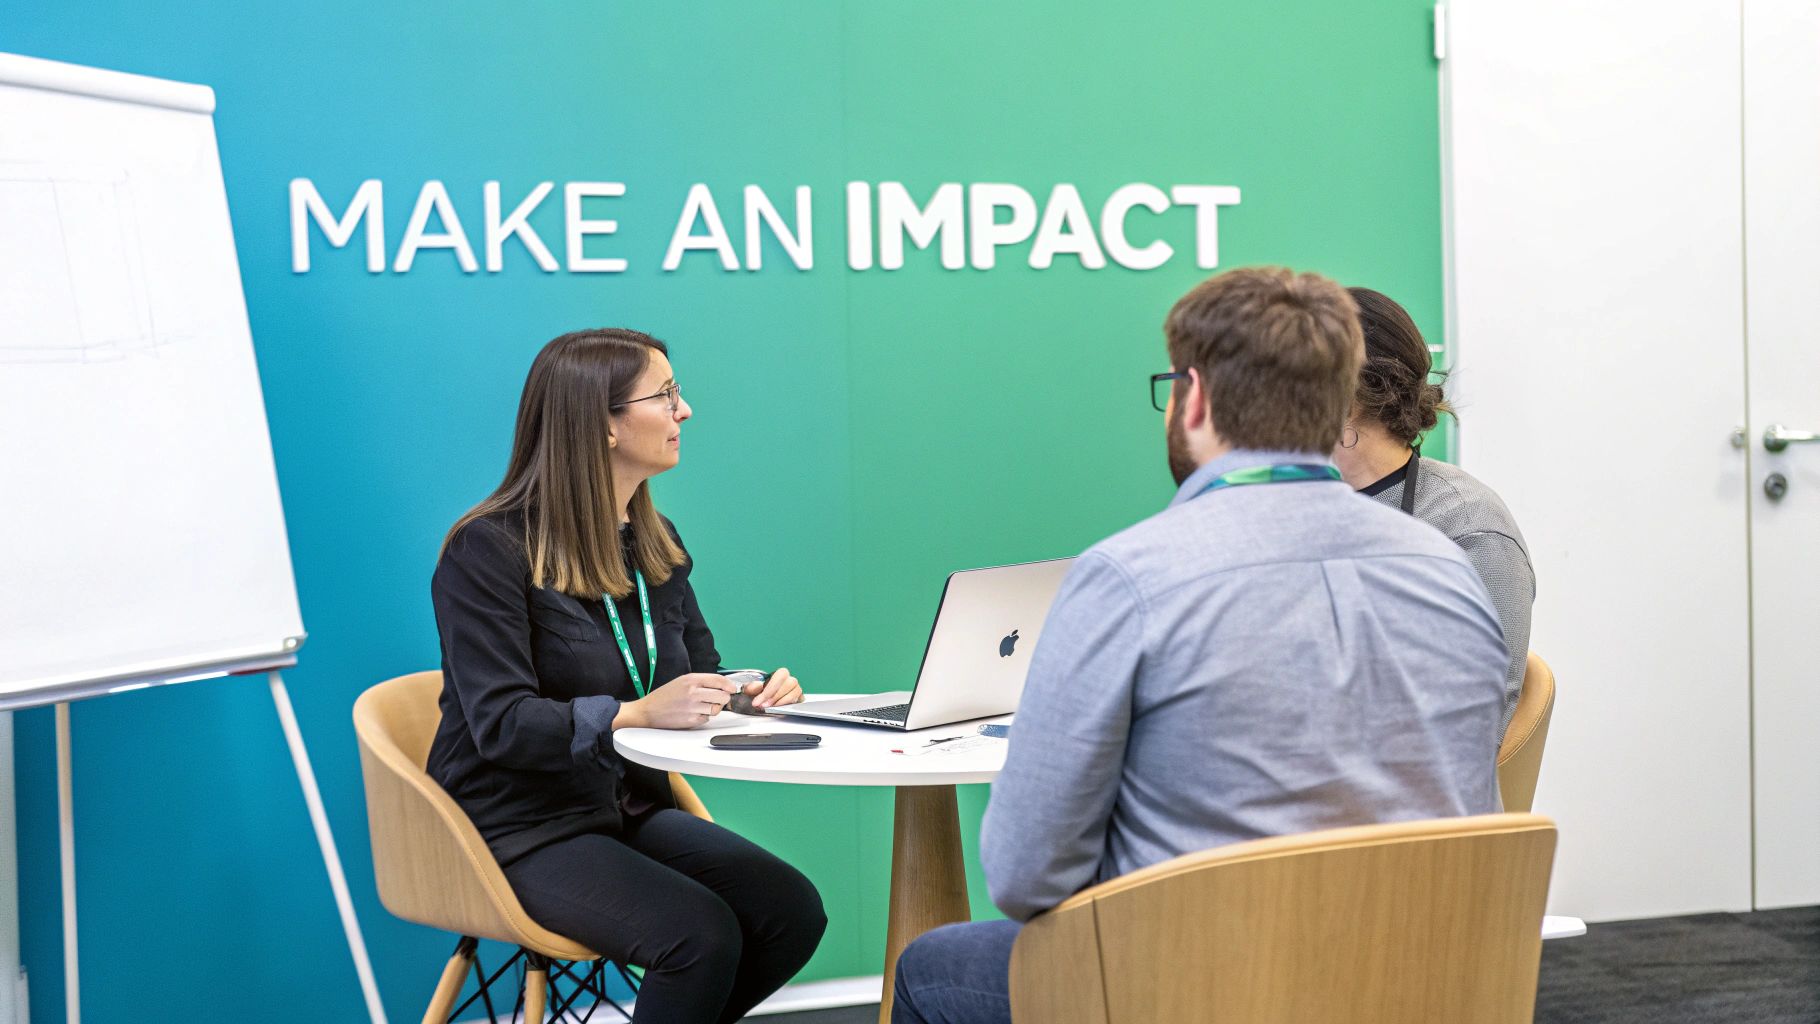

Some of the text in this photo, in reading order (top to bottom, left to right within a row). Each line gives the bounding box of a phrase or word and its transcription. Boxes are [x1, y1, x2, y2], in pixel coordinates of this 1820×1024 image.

[289, 178, 1242, 273] MAKE AN IMPACT
